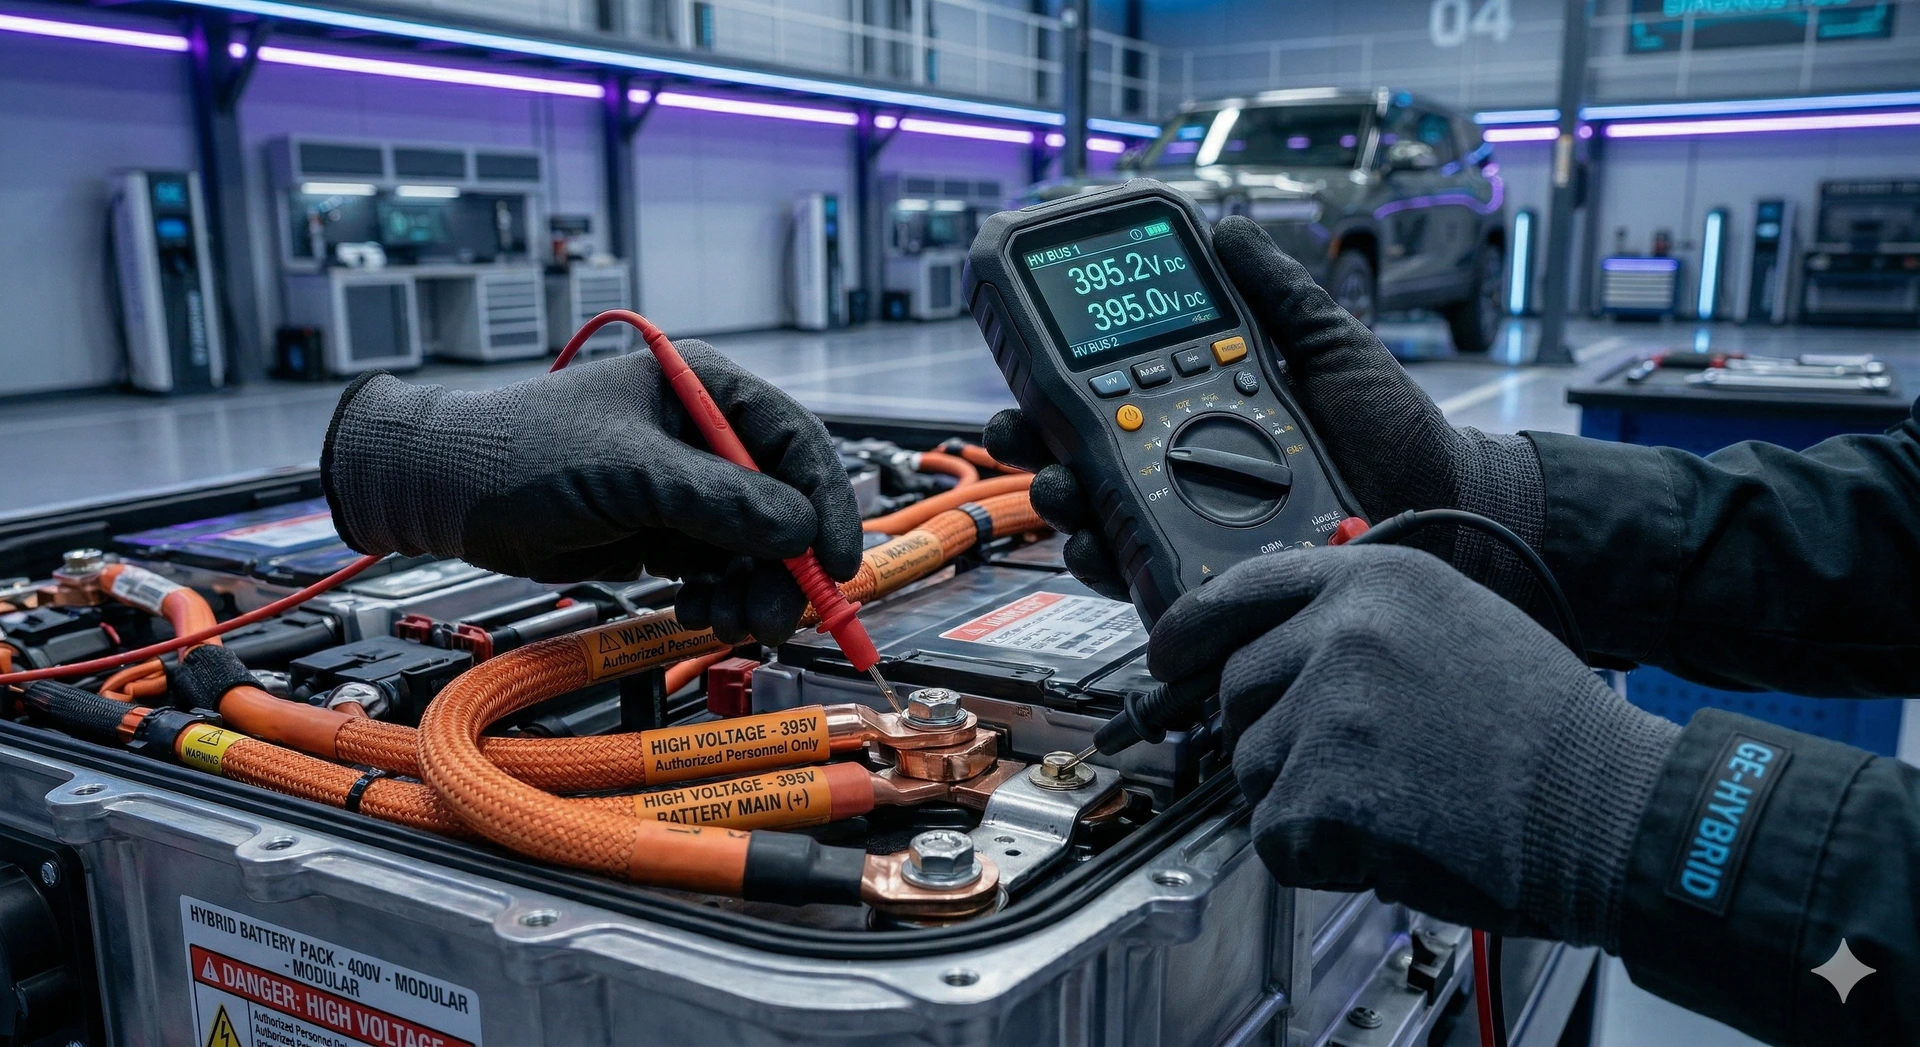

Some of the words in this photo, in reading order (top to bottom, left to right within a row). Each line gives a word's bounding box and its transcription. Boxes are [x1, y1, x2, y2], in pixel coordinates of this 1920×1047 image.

[1429, 0, 1512, 47] 04
[1027, 254, 1045, 267] HV
[1047, 246, 1072, 263] BUS
[1073, 244, 1081, 256] 1
[1068, 252, 1162, 296] 395.2V
[1165, 256, 1186, 273] DC
[1087, 287, 1183, 331] 395.0V
[1185, 291, 1206, 308] DC
[1072, 345, 1090, 358] HV
[1090, 339, 1111, 355] BUS
[1110, 336, 1120, 347] 2
[1148, 487, 1169, 502] OFF
[602, 646, 665, 670] Authorized
[668, 632, 717, 653] Personne
[616, 617, 687, 647] WARNIN
[651, 737, 691, 756] HIGH
[697, 724, 767, 749] VOLTAGE
[779, 716, 818, 736] 395V
[655, 753, 723, 772] Authorized
[726, 743, 788, 763] Personnel
[791, 737, 819, 752] Only
[643, 792, 686, 809] HIGH
[689, 777, 764, 801] VOLTAGE
[776, 770, 816, 787] 395V
[737, 793, 782, 817] MAIN
[787, 788, 810, 811] (+)
[1680, 742, 1774, 899] GE-HYBRID
[190, 904, 237, 935] HYBRID
[239, 920, 296, 955] BATTERY
[299, 940, 336, 968] PACK
[347, 957, 381, 984] 400V
[394, 972, 469, 1014] MODULAR
[222, 961, 301, 1013] DANGER:
[305, 992, 352, 1031] HIGH
[292, 960, 360, 998] MODULAR
